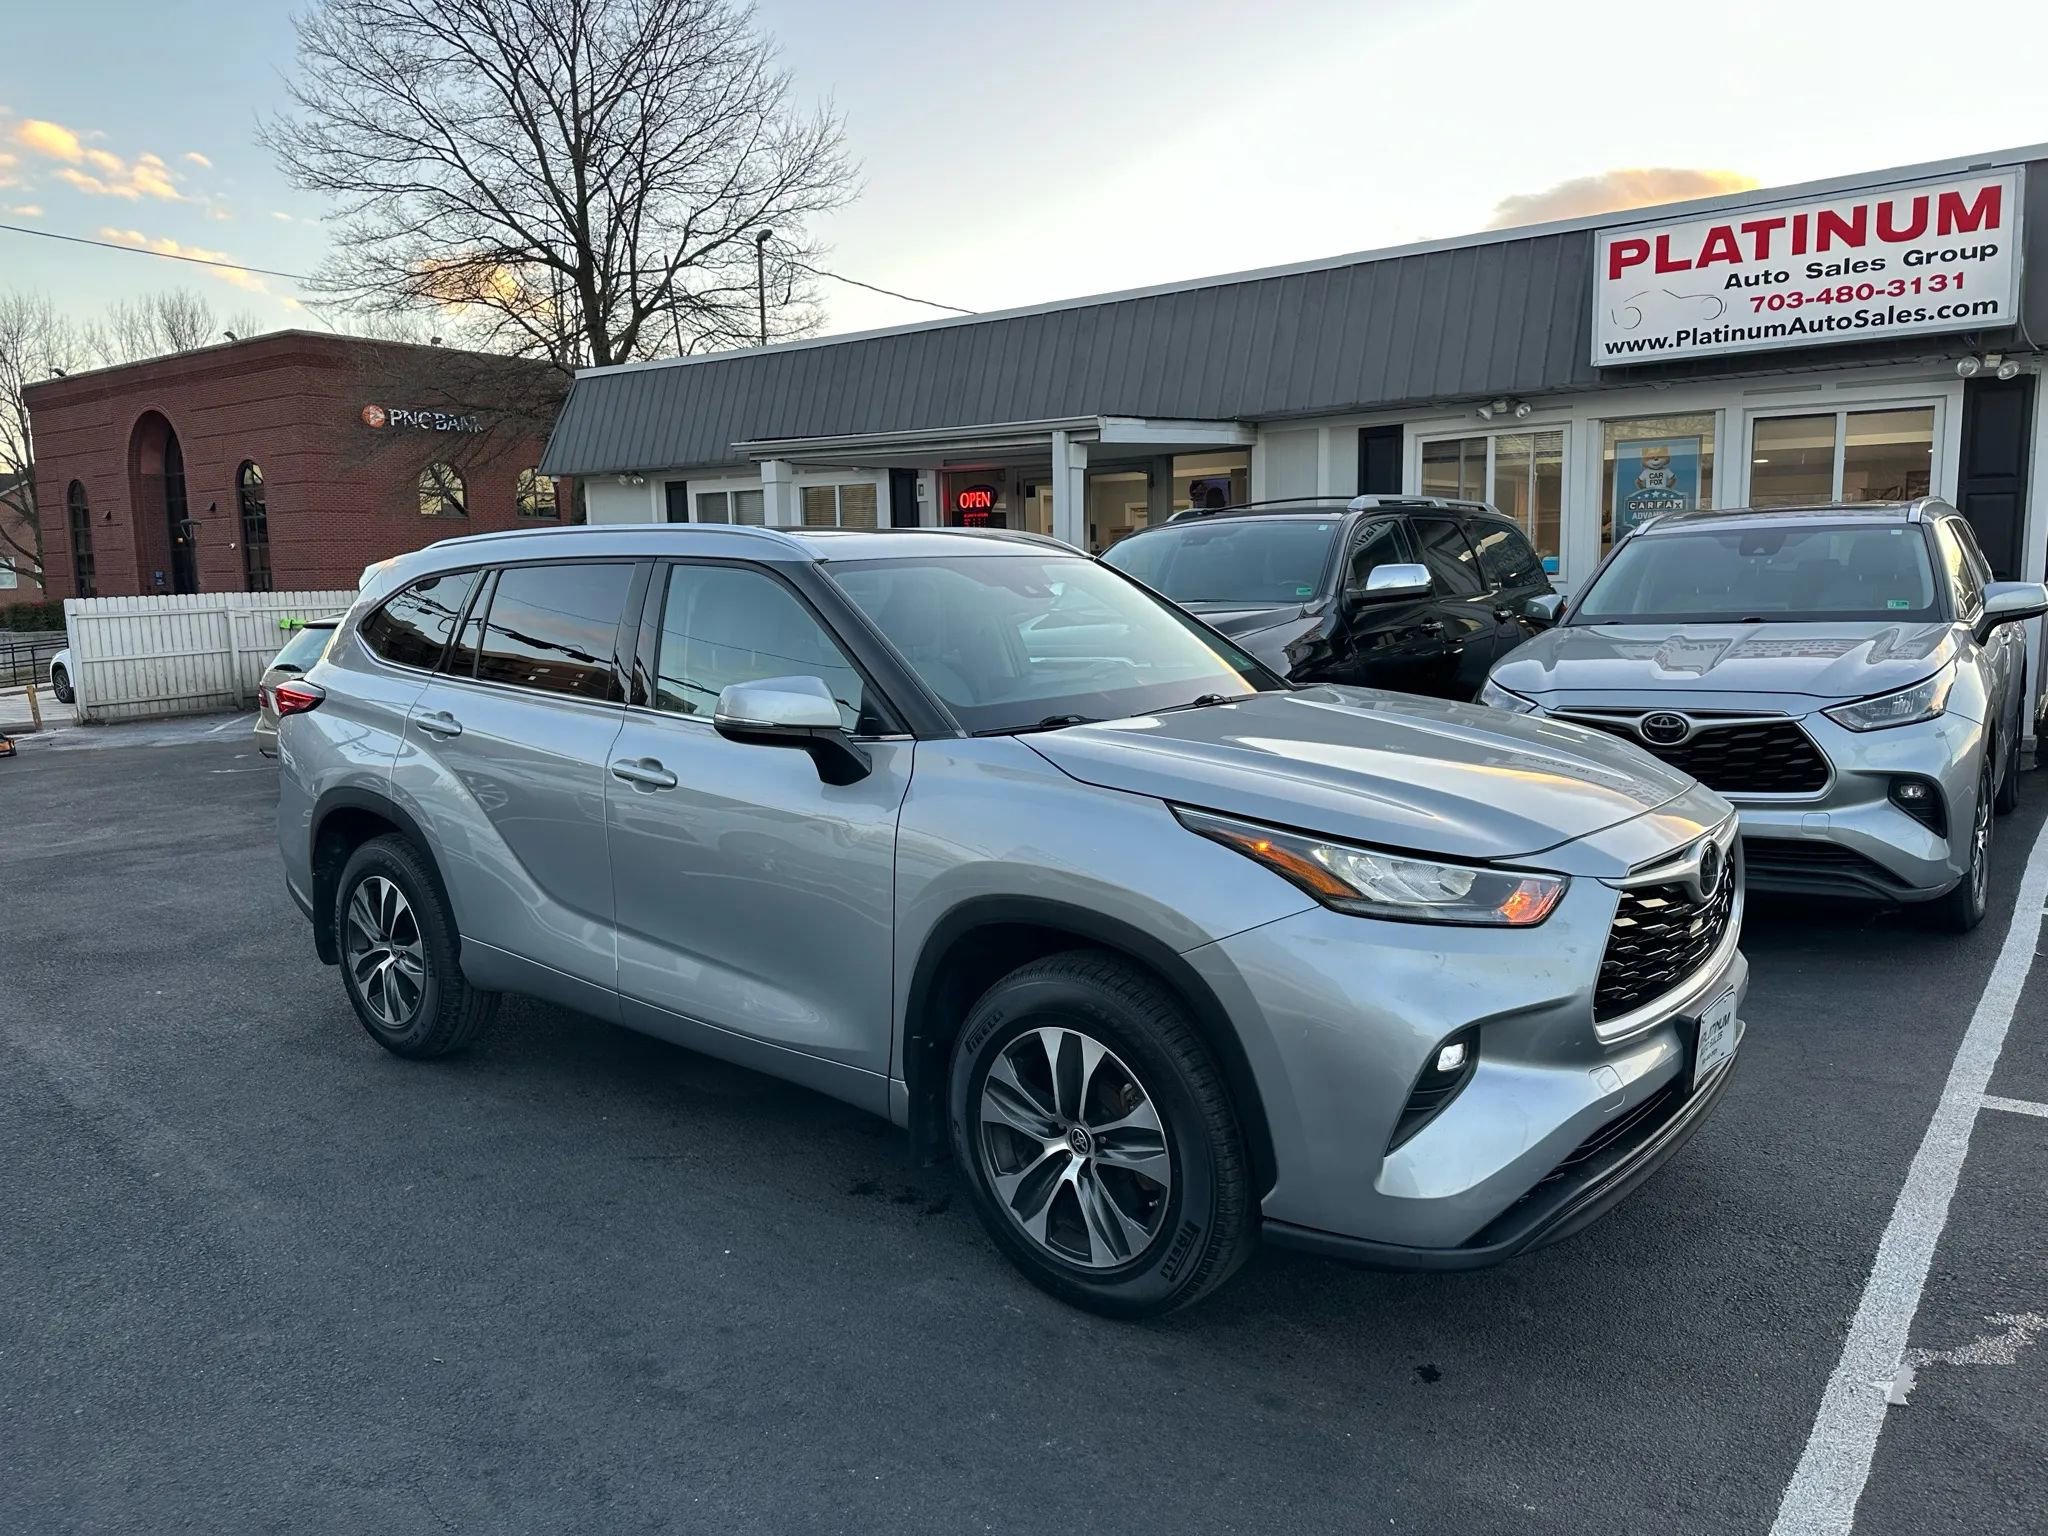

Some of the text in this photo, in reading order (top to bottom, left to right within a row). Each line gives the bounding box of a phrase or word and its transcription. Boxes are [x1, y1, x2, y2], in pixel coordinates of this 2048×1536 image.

[1608, 185, 2003, 281] PLATINUM
[1724, 243, 1999, 290] Auto Sales Group
[1750, 272, 1965, 313] 703-480-3131
[1604, 300, 1999, 355] www.PlatinumAutoSales.com
[959, 491, 991, 509] OPEN
[1628, 499, 1683, 510] CARFAX
[964, 1010, 1004, 1056] PIRELLI
[1160, 1219, 1202, 1283] PIRELLI
